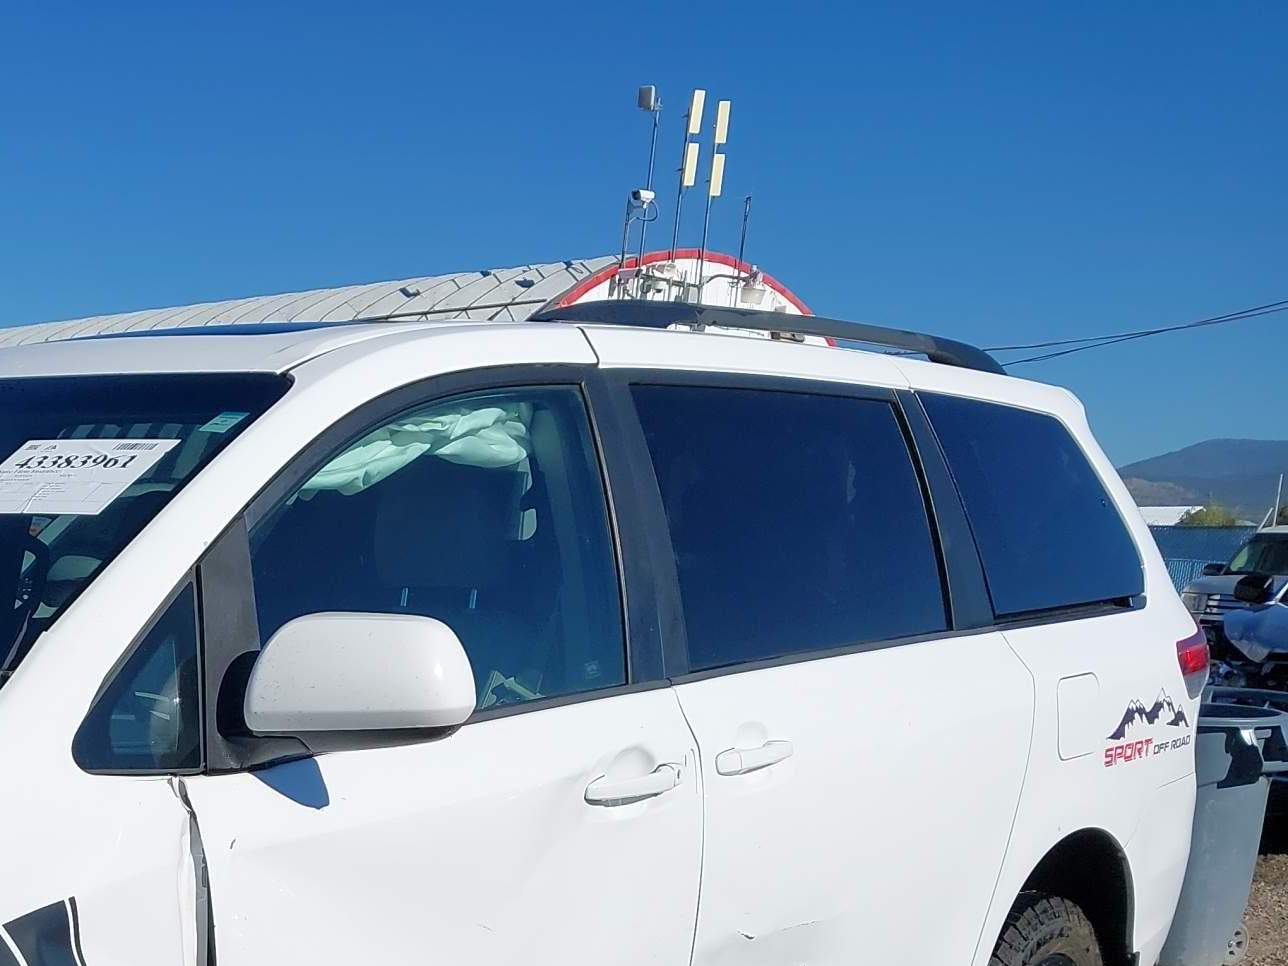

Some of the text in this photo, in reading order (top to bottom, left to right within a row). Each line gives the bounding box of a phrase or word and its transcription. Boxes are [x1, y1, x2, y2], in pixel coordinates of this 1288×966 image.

[15, 454, 137, 469] 43383961
[1104, 735, 1191, 767] SPORT OFF ROAD
